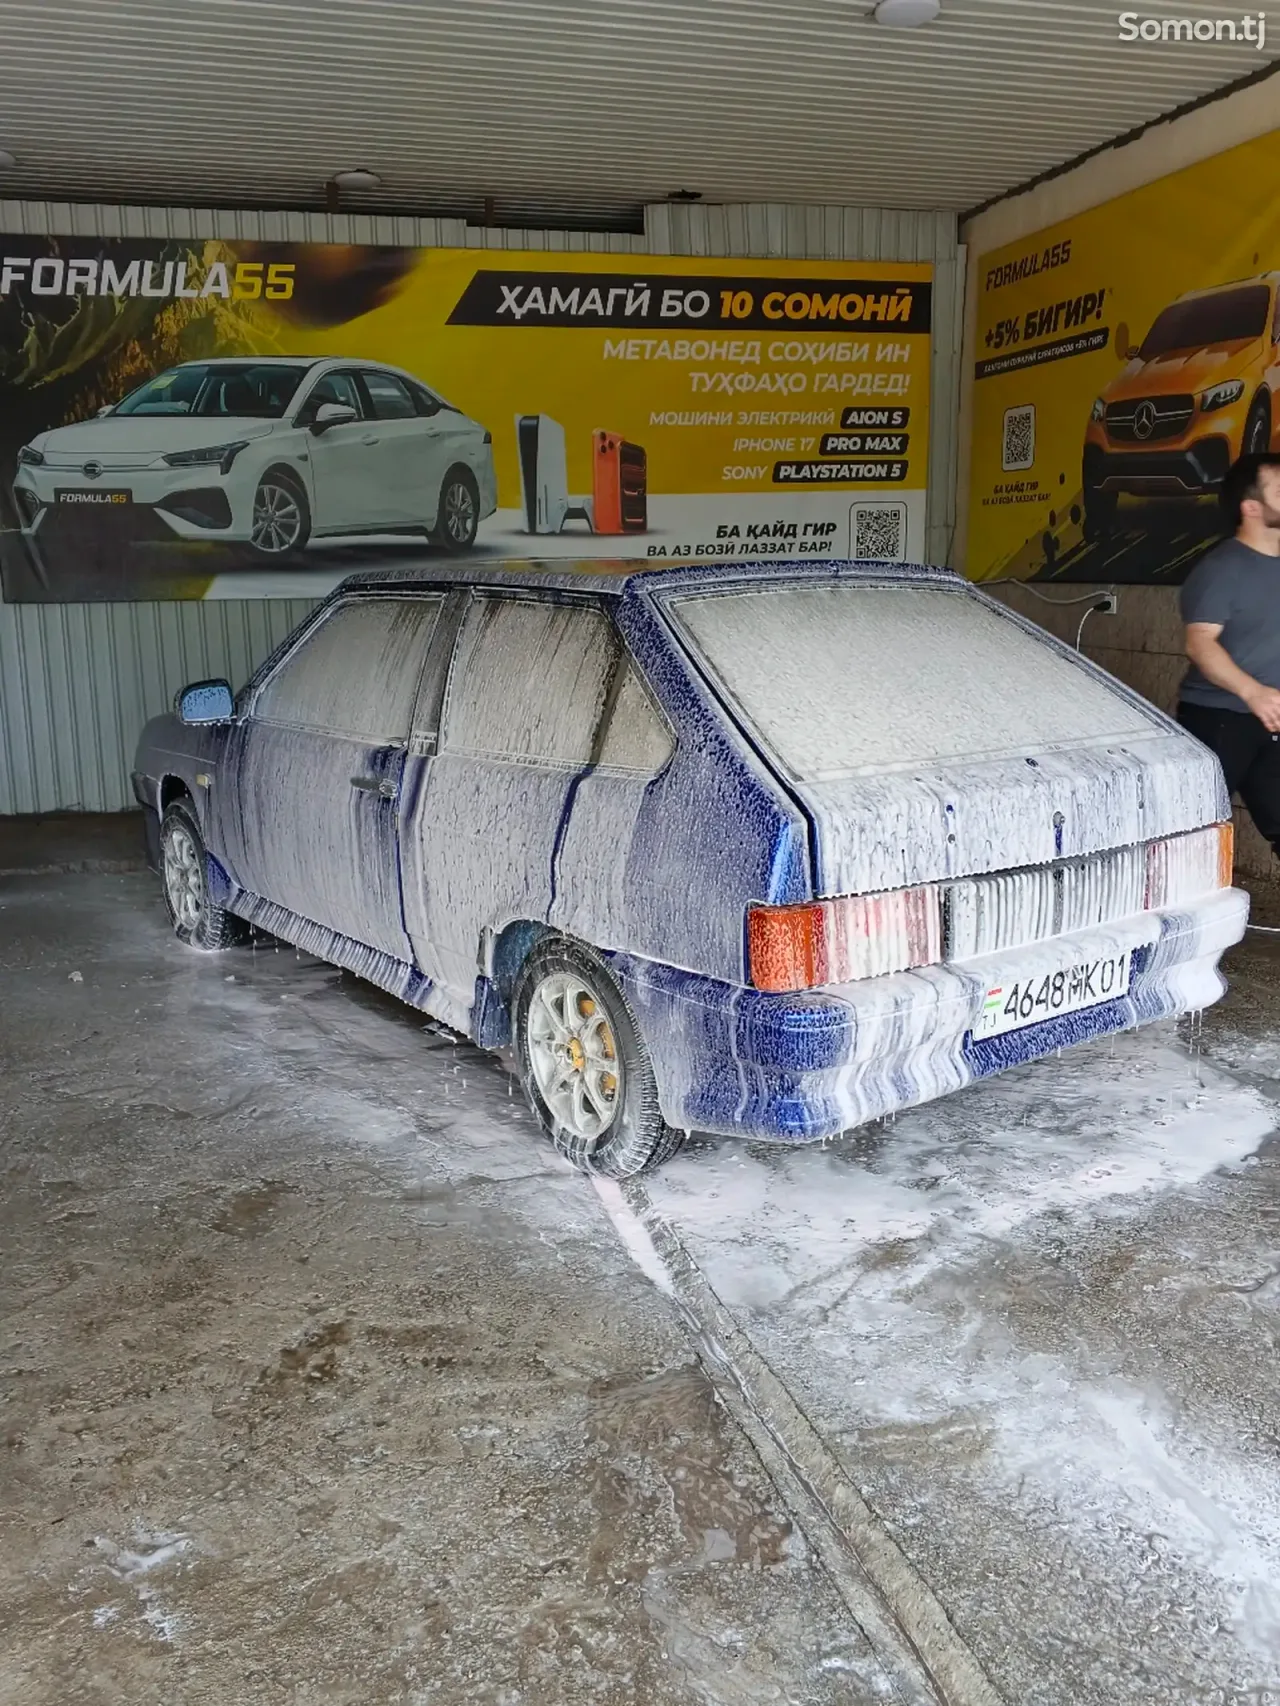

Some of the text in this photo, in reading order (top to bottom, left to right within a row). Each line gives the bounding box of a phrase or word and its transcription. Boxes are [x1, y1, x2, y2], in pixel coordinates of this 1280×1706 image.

[986, 240, 1072, 292] FORMULA55
[1, 257, 296, 300] FORMULA55
[659, 289, 711, 318] БО
[720, 291, 754, 319] 10
[985, 288, 1106, 349] +5% БИГИР!
[603, 339, 911, 365] МЕТАВОНЕД СОҲИБИ ИН
[813, 373, 912, 397] ГАРДЕД!
[649, 411, 733, 427] МОШИНИ
[846, 411, 889, 425] AION
[891, 410, 903, 425] S
[733, 436, 903, 452] IPHONE 17 PRO MAX
[721, 463, 901, 481] SONY PLAYSTATION 5
[60, 493, 127, 503] FORMULA55
[716, 525, 741, 539] БА
[802, 522, 837, 537] ГИР
[647, 545, 669, 557] ВА
[671, 545, 691, 557] АЗ
[738, 542, 796, 555] ЛАЗЗАТ
[798, 541, 833, 553] БАР!
